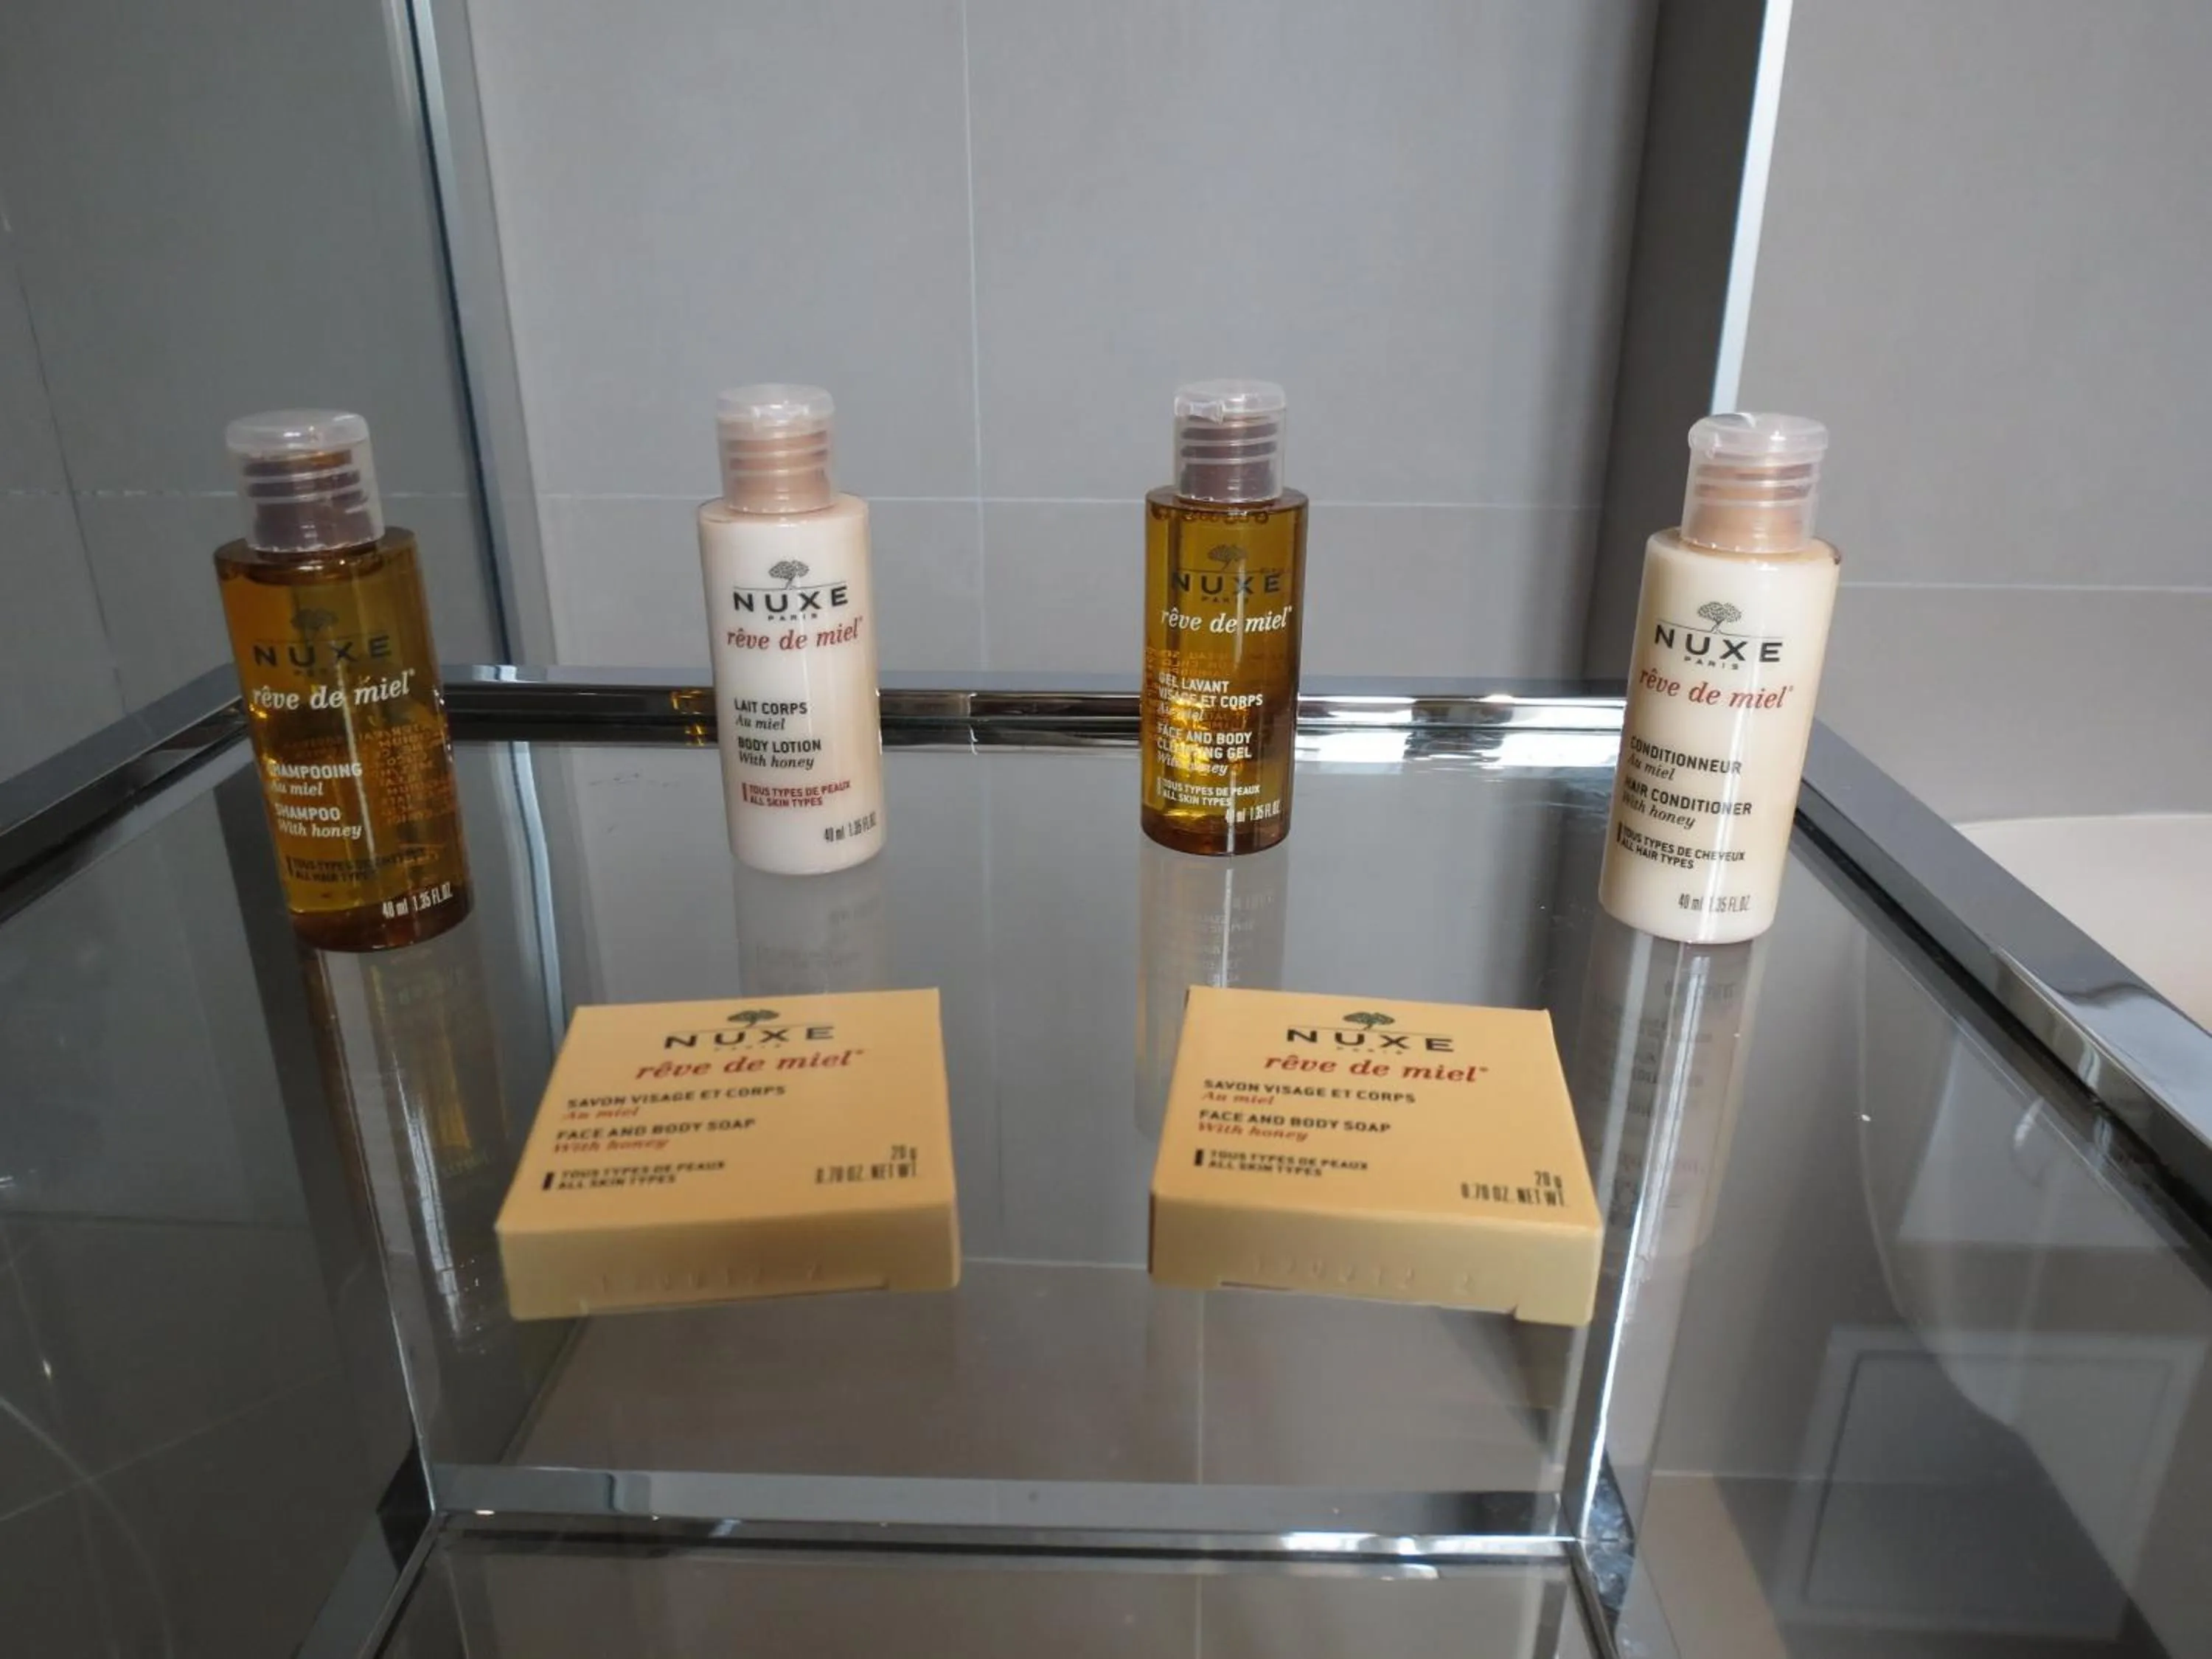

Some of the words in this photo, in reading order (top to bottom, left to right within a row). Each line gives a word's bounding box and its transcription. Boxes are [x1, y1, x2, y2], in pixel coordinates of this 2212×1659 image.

[1172, 572, 1281, 594] NUXE
[733, 586, 848, 612] NUXE
[1161, 607, 1203, 631] rêve
[1209, 613, 1238, 633] de
[727, 628, 770, 650] rêve
[779, 629, 807, 650] de
[1655, 625, 1783, 662] NUXE
[253, 636, 392, 667] NUXE
[1683, 655, 1739, 670] PARIS
[1182, 678, 1229, 693] LAVANT
[1639, 667, 1680, 697] rêve
[1688, 681, 1721, 705] de
[252, 686, 299, 710] rêve
[310, 685, 344, 709] de
[734, 698, 758, 713] LAIT
[762, 701, 808, 715] CORPS
[1201, 695, 1217, 708] ET
[1220, 694, 1263, 708] CORPS
[756, 717, 785, 730] miel
[1158, 723, 1183, 738] FACE
[1186, 731, 1211, 744] AND
[1217, 731, 1252, 745] BODY
[738, 736, 768, 751] BODY
[772, 739, 821, 754] LOTION
[1227, 746, 1252, 760] GEL
[1630, 735, 1742, 774] CONDITIONNEUR
[739, 750, 766, 767] With
[771, 754, 814, 771] honey
[1644, 762, 1675, 781] miel
[290, 782, 323, 796] miel
[749, 785, 771, 796] TOUS
[773, 787, 803, 798] TYPES
[806, 787, 820, 796] DE
[1179, 793, 1199, 804] SKIN
[1202, 797, 1232, 807] TYPES
[1184, 785, 1214, 795] TYPES
[1231, 785, 1260, 796] PEAUX
[1624, 775, 1648, 798] HAIR
[1651, 788, 1753, 816] CONDITIONER
[768, 799, 789, 807] SKIN
[792, 796, 823, 808] TYPES
[1649, 804, 1696, 830] honey
[312, 823, 362, 840] honey
[1635, 846, 1658, 860] HAIR
[1660, 855, 1694, 869] TYPES
[1644, 835, 1674, 854] TYPES
[1677, 846, 1693, 858] DE
[1694, 849, 1746, 862] CHEVEUX
[665, 1026, 834, 1049] NUXE
[1287, 1029, 1454, 1052] NUXE
[635, 1061, 712, 1080] rêve
[723, 1056, 765, 1074] de
[1265, 1054, 1338, 1074] rêve
[1349, 1059, 1390, 1077] de
[567, 1096, 626, 1109] SAVON
[632, 1091, 695, 1105] VISAGE
[700, 1088, 721, 1099] ET
[725, 1085, 786, 1099] CORPS
[1204, 1079, 1259, 1093] SAVON
[1264, 1085, 1326, 1097] VISAGE
[1331, 1088, 1352, 1099] ET
[1357, 1090, 1416, 1104] CORPS
[1233, 1094, 1275, 1105] miel
[556, 1127, 602, 1141] FACE
[607, 1124, 647, 1138] AND
[652, 1121, 703, 1135] BODY
[706, 1118, 756, 1131] SOAP
[1199, 1108, 1243, 1122] FACE
[1248, 1113, 1285, 1126] AND
[1290, 1116, 1340, 1130] BODY
[1343, 1121, 1391, 1133] SOAP
[1198, 1121, 1243, 1135] With
[1248, 1126, 1309, 1143] honey
